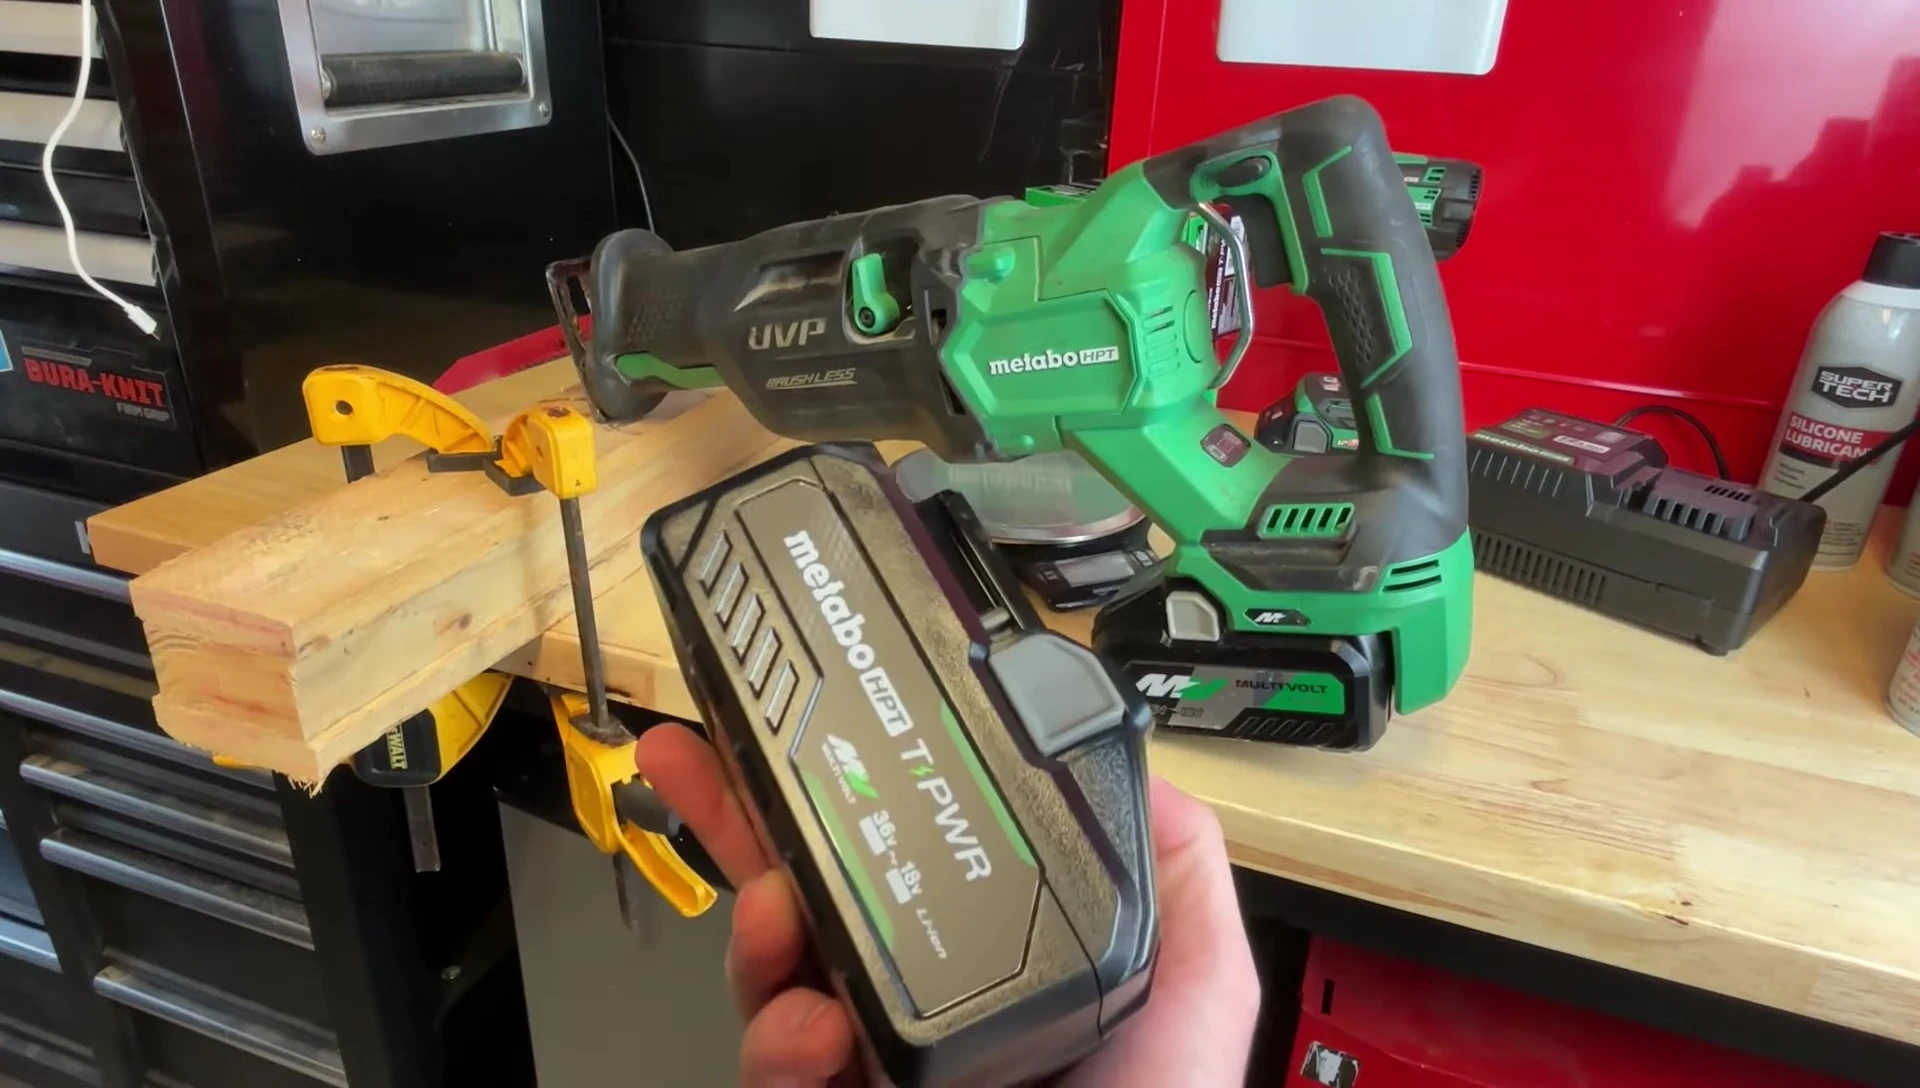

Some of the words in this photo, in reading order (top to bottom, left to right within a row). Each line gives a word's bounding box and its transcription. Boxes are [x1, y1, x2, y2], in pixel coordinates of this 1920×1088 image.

[747, 318, 827, 350] UVP
[989, 350, 1078, 375] metabo
[1081, 348, 1117, 363] HPT
[766, 368, 856, 388] BRUSHLESS
[1818, 379, 1890, 403] TECH
[1819, 370, 1893, 392] SUPER
[1785, 428, 1872, 459] LUBRICAN
[1790, 415, 1864, 444] SILICONE
[784, 530, 874, 670] metabo
[863, 671, 911, 733] HPT
